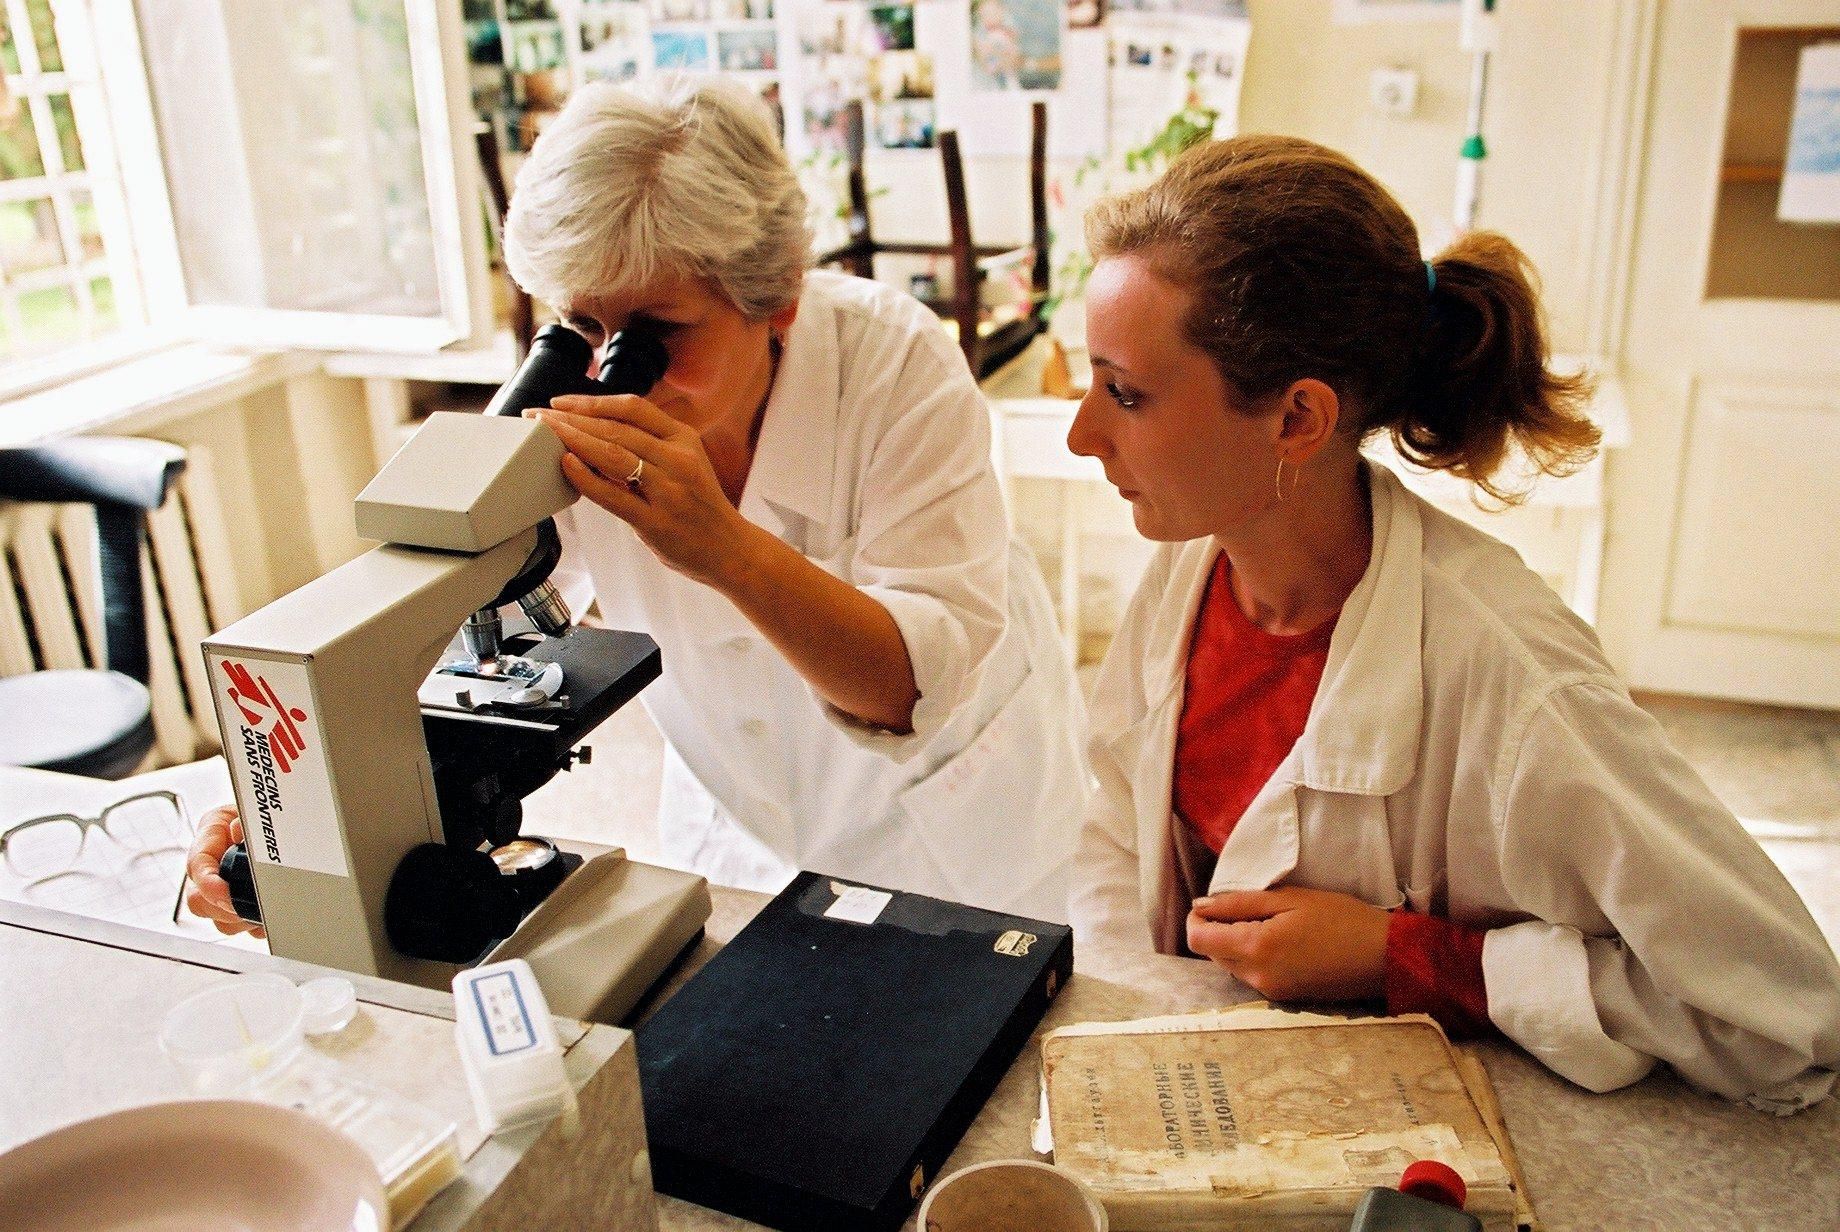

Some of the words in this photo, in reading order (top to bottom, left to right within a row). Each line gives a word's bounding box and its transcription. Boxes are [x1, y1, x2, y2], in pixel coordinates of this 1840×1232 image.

[240, 724, 260, 769] SANS
[250, 769, 282, 864] FRONTIERES
[254, 730, 283, 812] MEDECINS
